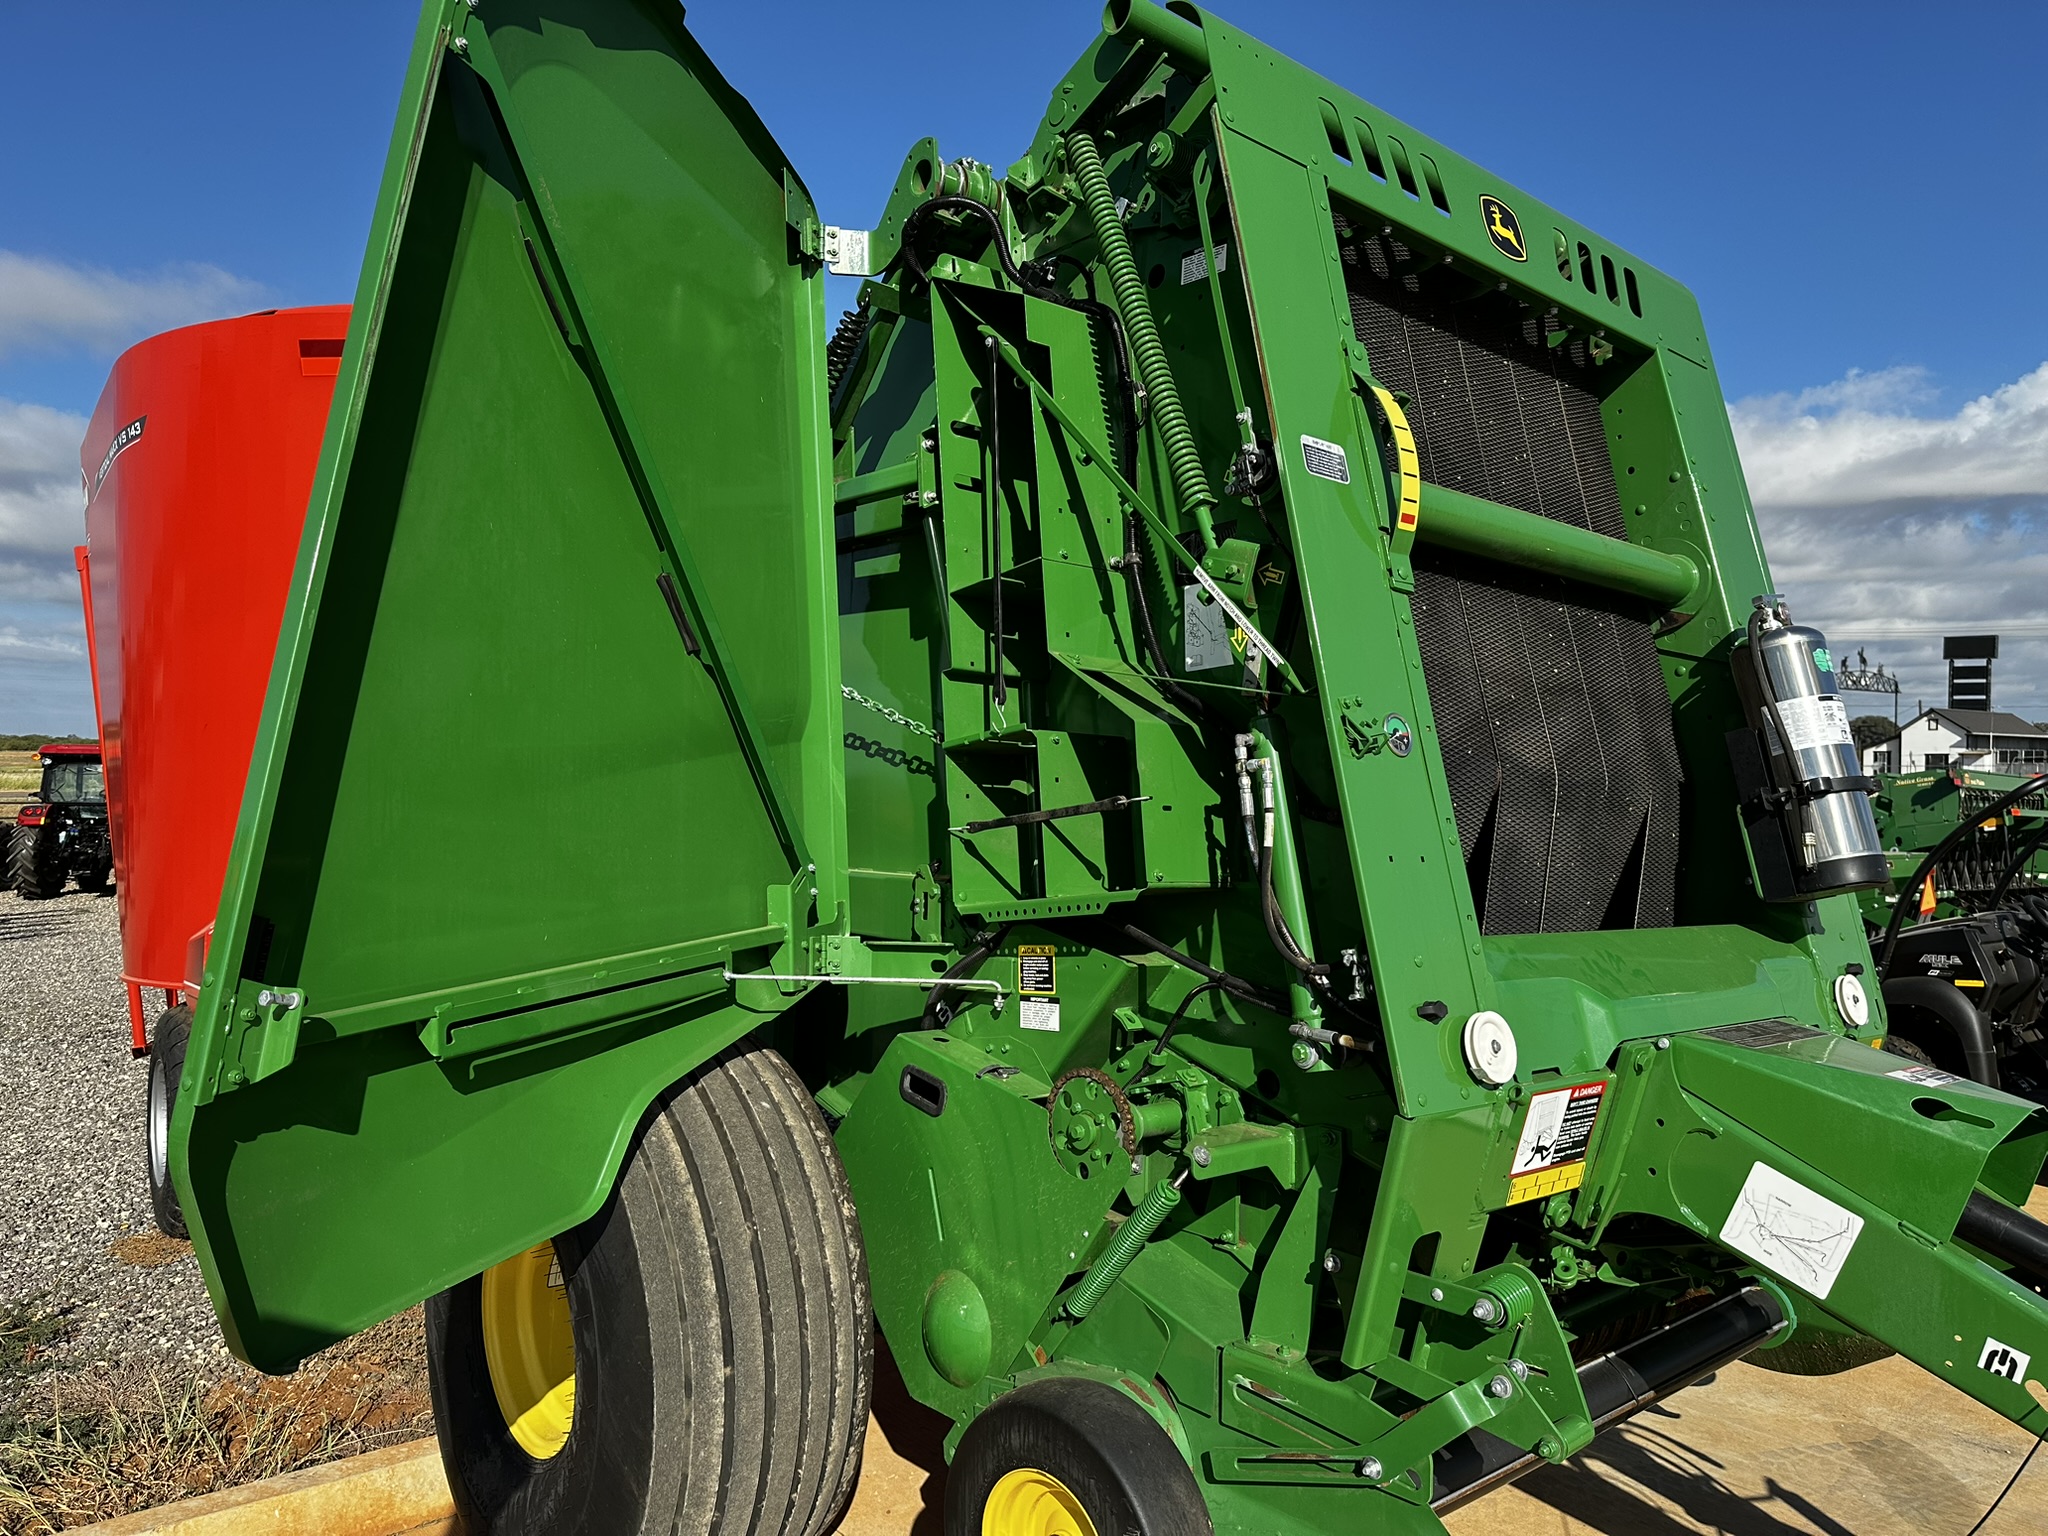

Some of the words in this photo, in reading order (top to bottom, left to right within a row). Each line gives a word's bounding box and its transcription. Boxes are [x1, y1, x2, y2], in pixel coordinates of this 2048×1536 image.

[118, 430, 127, 446] VS
[127, 421, 141, 438] 143
[1207, 582, 1215, 592] ARM
[1214, 591, 1224, 602] FROM
[1223, 601, 1235, 614] NOTCH
[1241, 620, 1253, 634] LOWER
[1257, 639, 1270, 654] THREAD
[1919, 954, 1963, 965] MULE
[1580, 1085, 1603, 1097] DANGER
